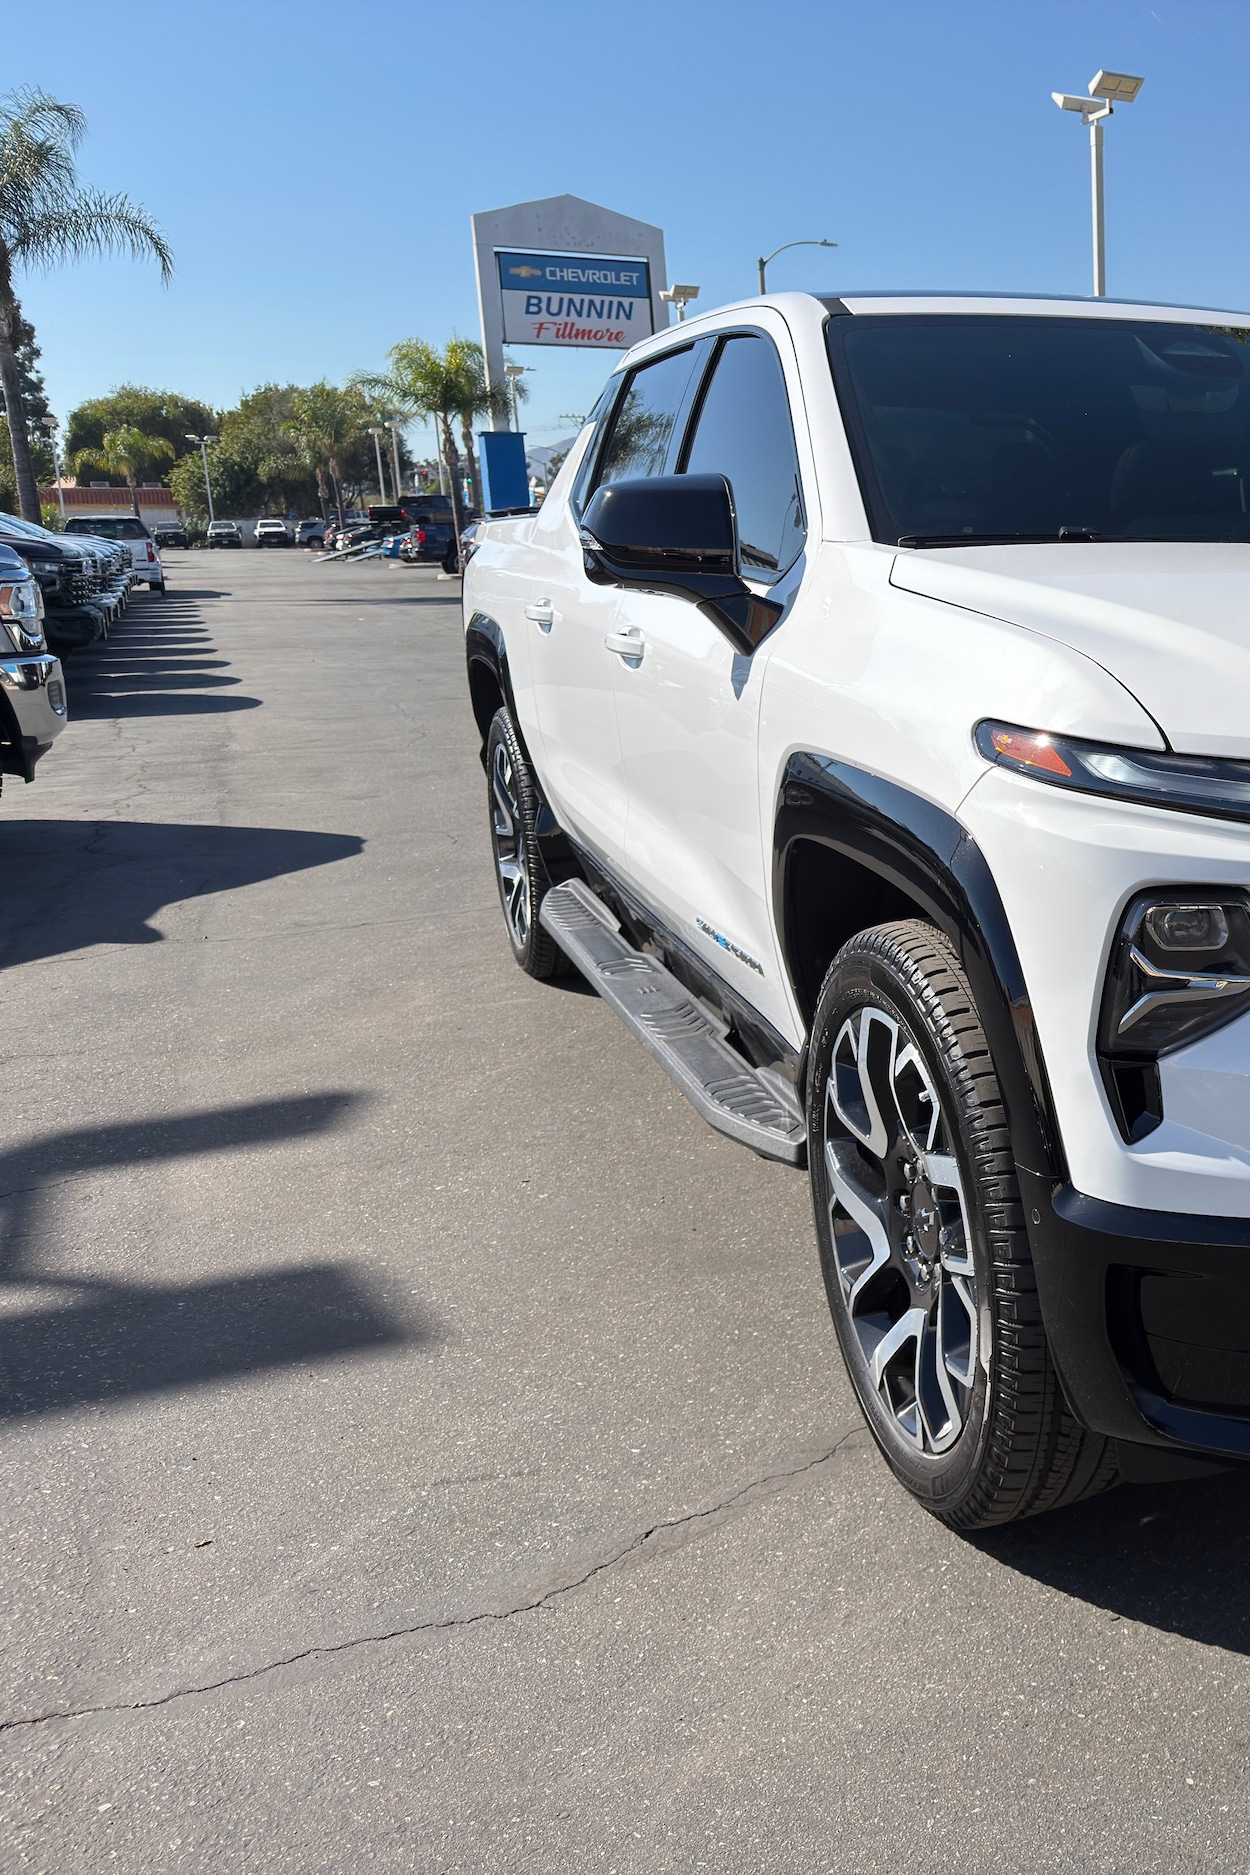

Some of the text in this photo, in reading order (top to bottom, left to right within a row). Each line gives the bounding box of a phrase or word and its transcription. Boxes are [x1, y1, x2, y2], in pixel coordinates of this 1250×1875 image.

[545, 267, 640, 286] CHEVROLET
[524, 295, 634, 321] BUNNIN
[530, 321, 626, 343] Fillmore
